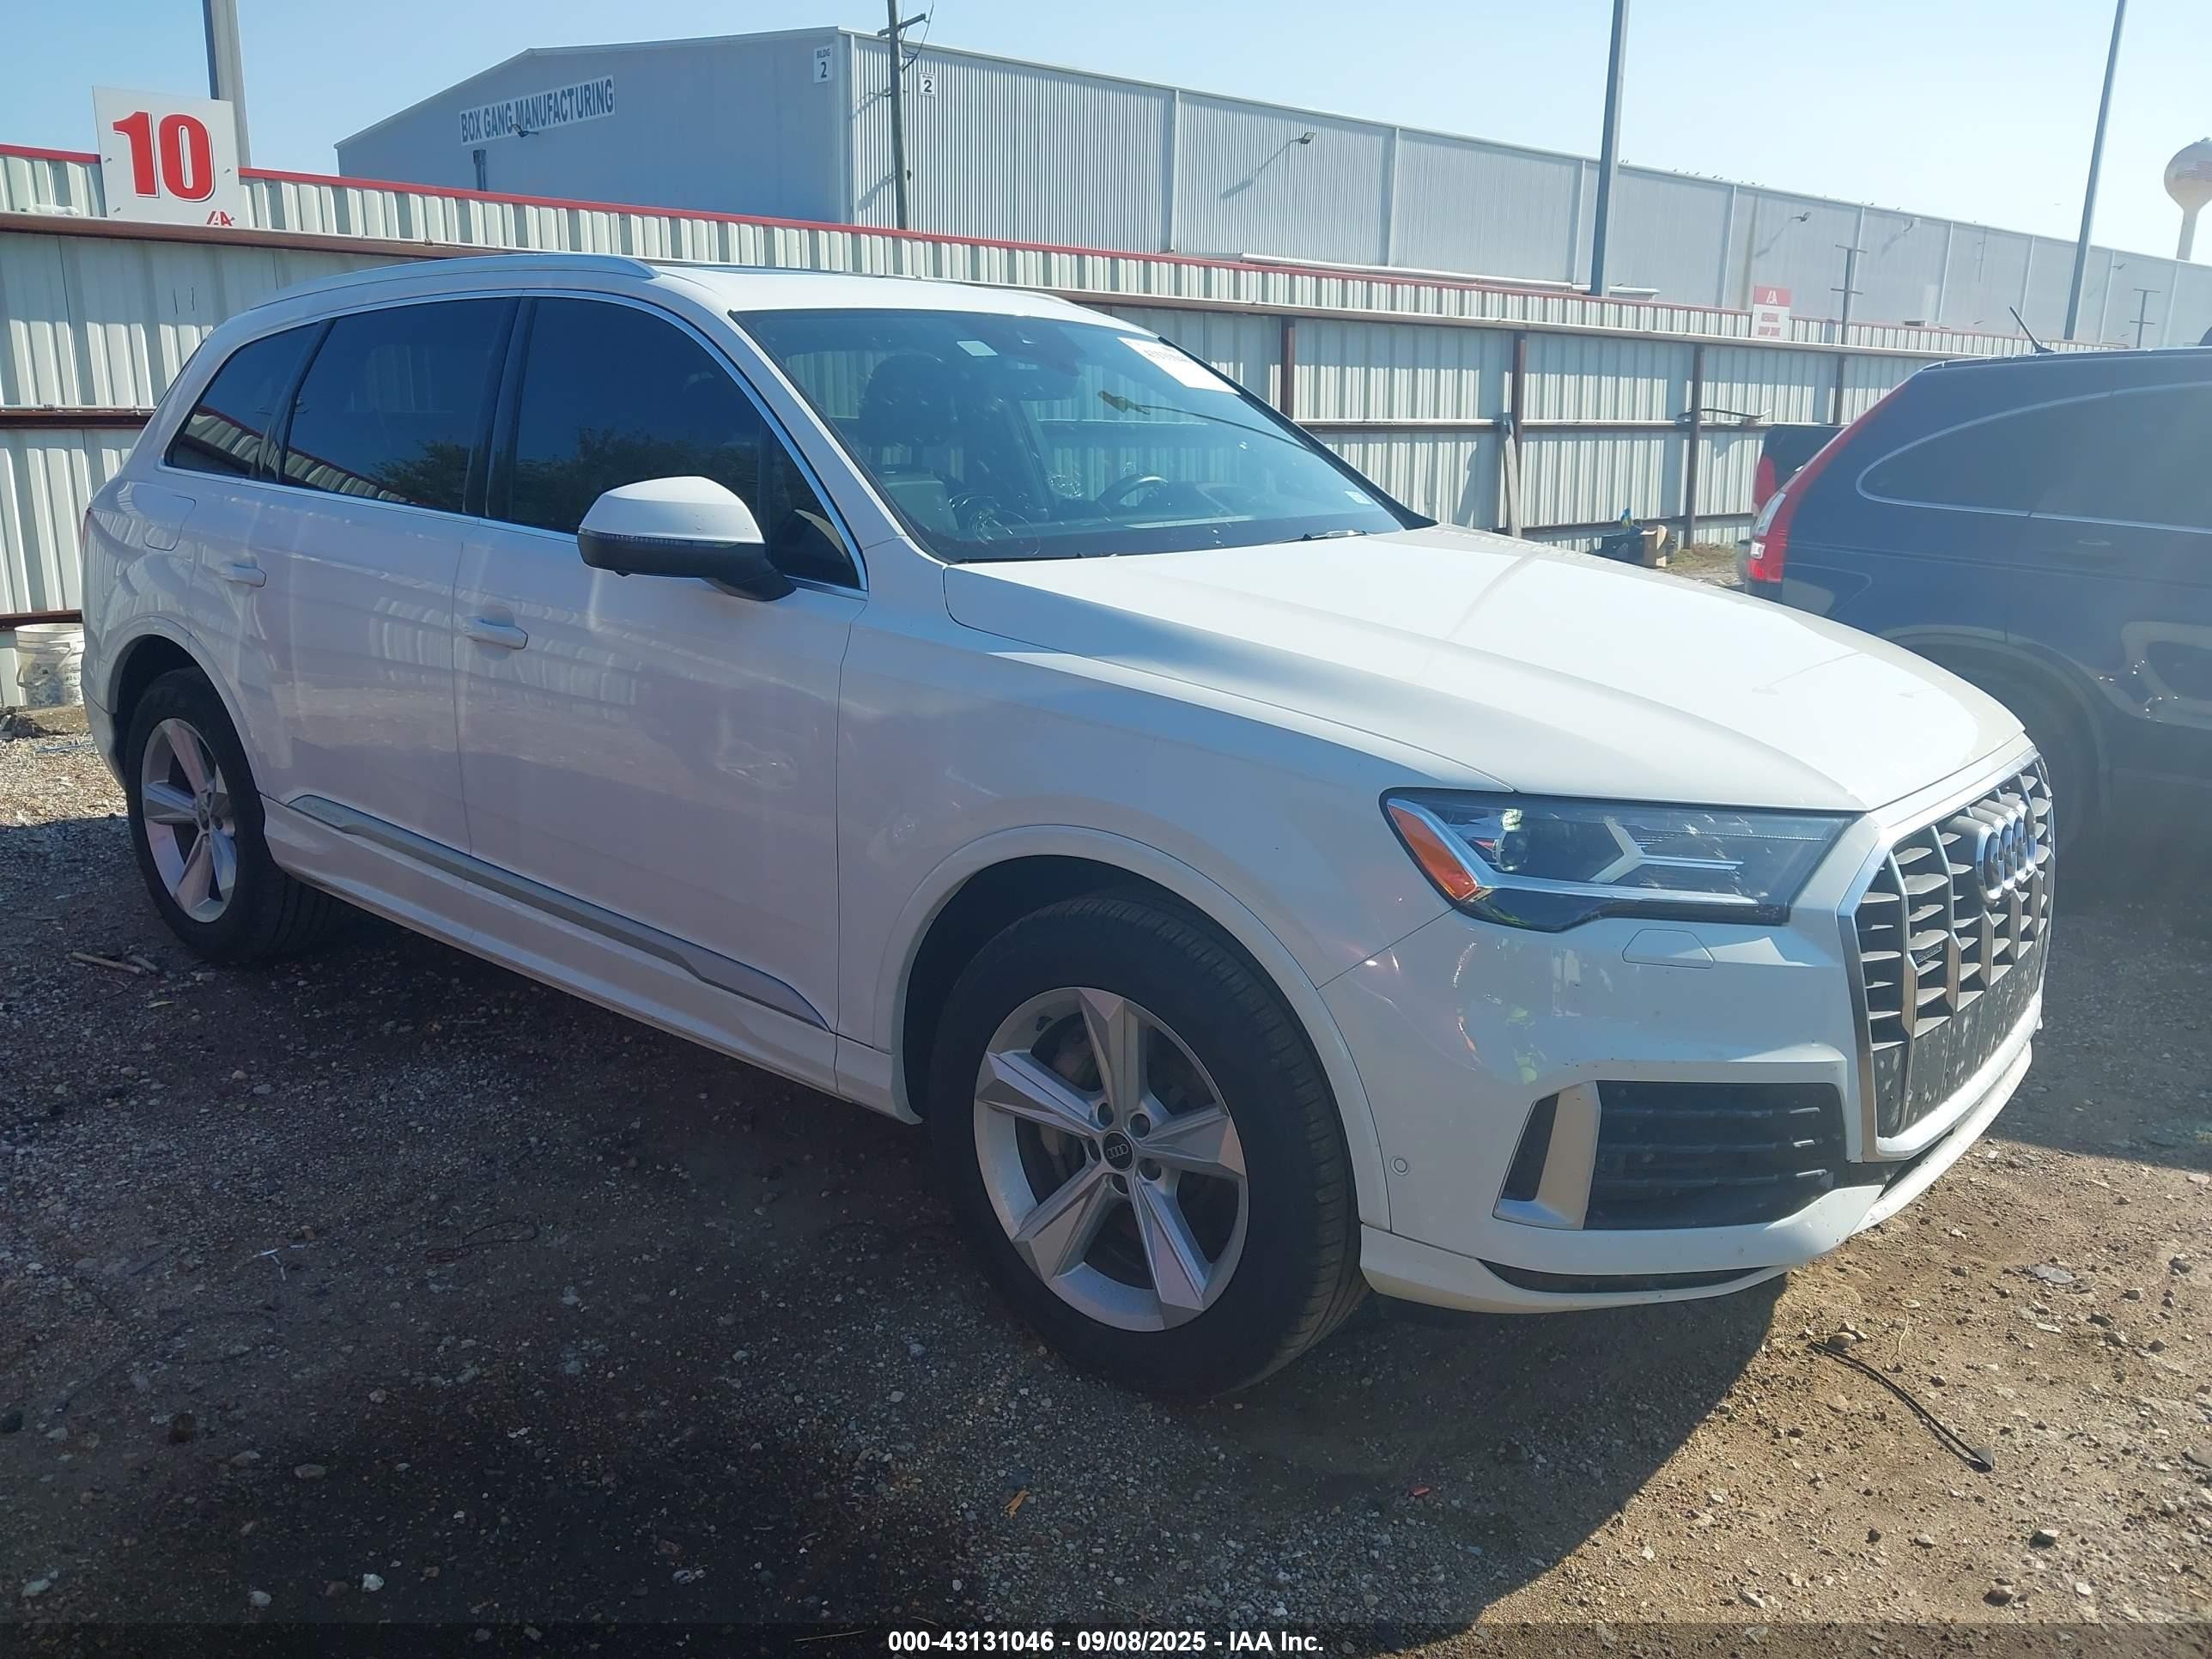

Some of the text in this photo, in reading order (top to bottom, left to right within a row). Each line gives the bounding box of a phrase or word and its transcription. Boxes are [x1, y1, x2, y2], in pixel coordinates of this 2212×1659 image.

[820, 61, 828, 78] 2
[923, 79, 933, 93] 2
[460, 78, 613, 143] BOX GANG MANUFACTURING
[112, 111, 216, 203] 10
